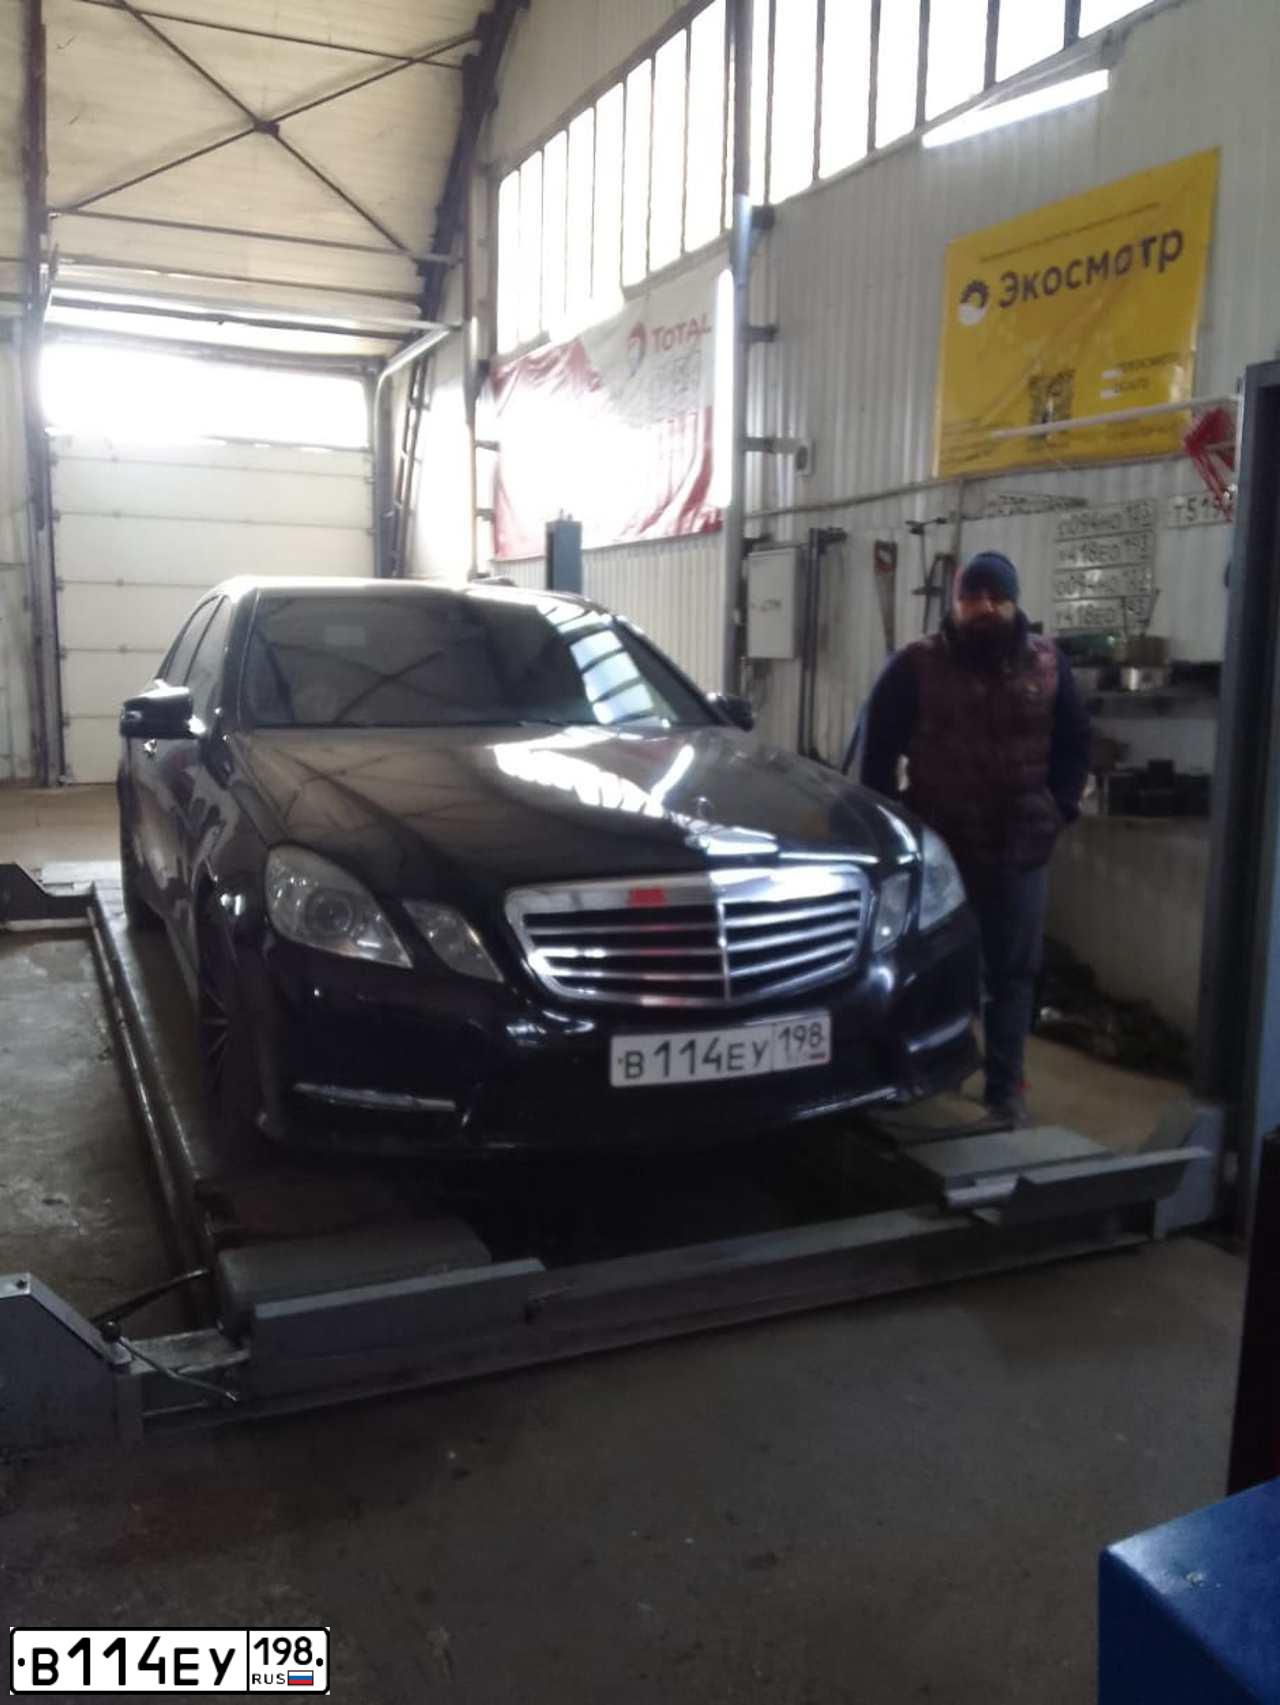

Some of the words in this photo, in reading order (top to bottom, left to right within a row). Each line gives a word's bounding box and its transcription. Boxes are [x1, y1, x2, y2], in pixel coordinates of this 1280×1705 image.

[998, 229, 1183, 309] Экосмотр
[652, 313, 712, 352] TOTAL
[624, 1036, 769, 1080] В114ЕУ
[778, 1021, 823, 1055] 198
